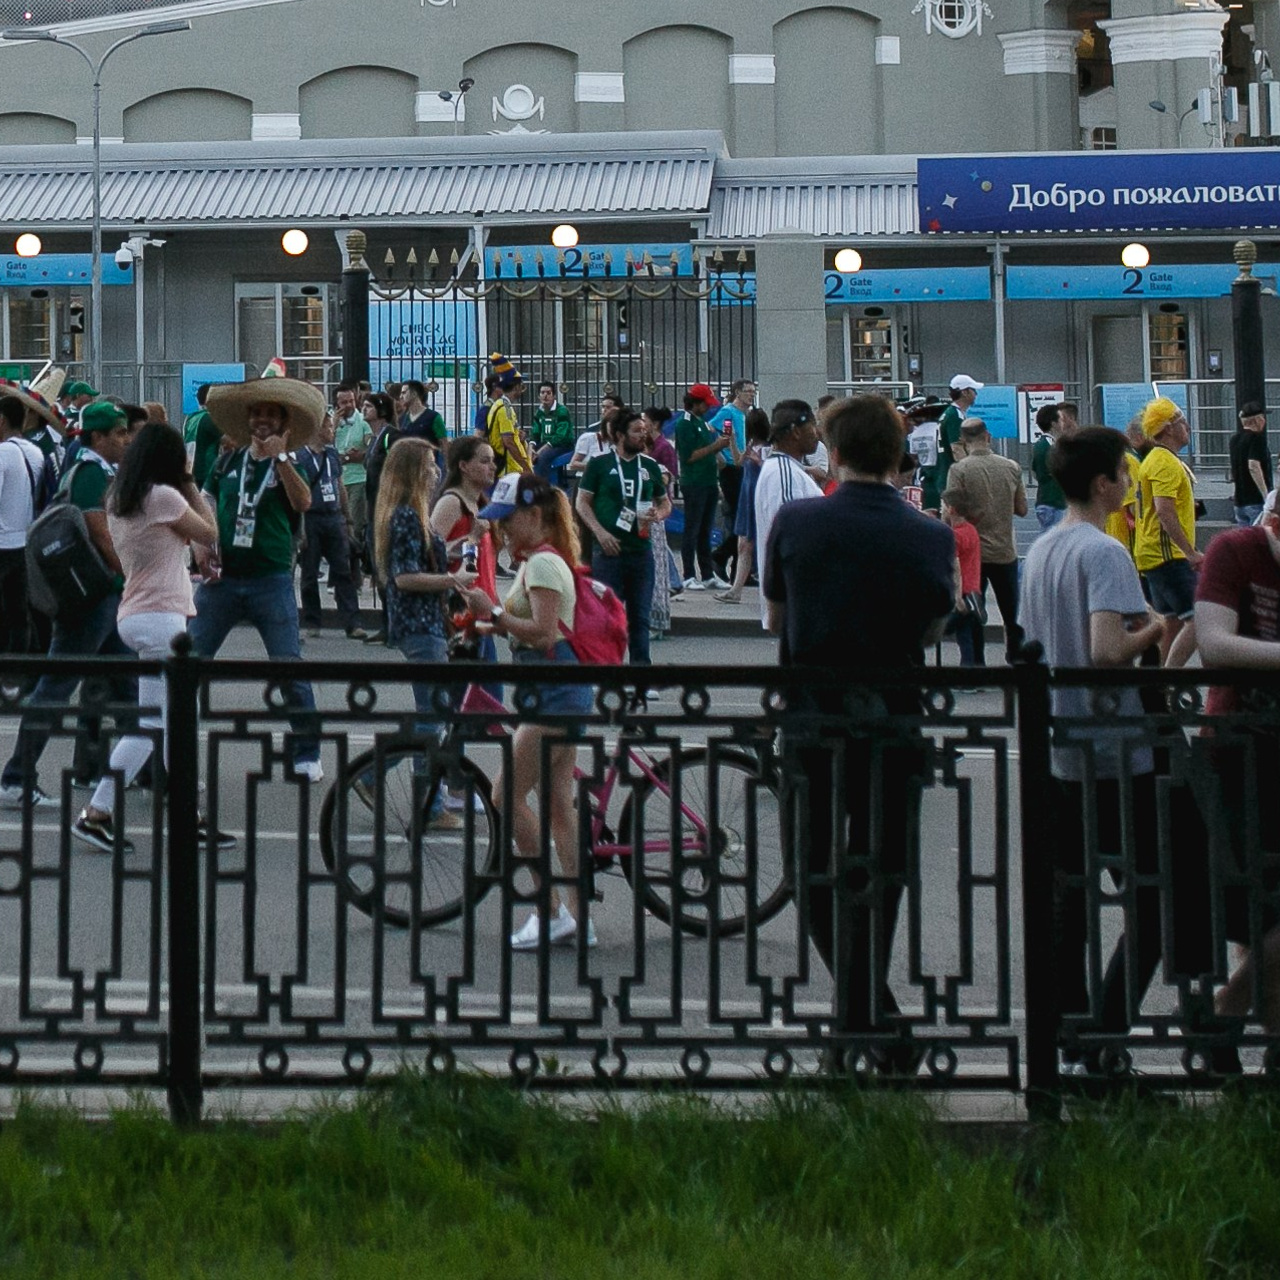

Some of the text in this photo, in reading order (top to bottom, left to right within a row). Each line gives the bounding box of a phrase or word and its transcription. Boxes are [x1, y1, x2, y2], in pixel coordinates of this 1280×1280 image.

[1009, 183, 1280, 213] Добро пожаловат
[6, 261, 27, 270] Gate
[563, 248, 583, 273] 2
[824, 274, 844, 299] 2
[849, 278, 873, 286] Gate
[1122, 269, 1144, 294] 2
[1149, 273, 1173, 282] Gate
[401, 323, 441, 334] CHECK
